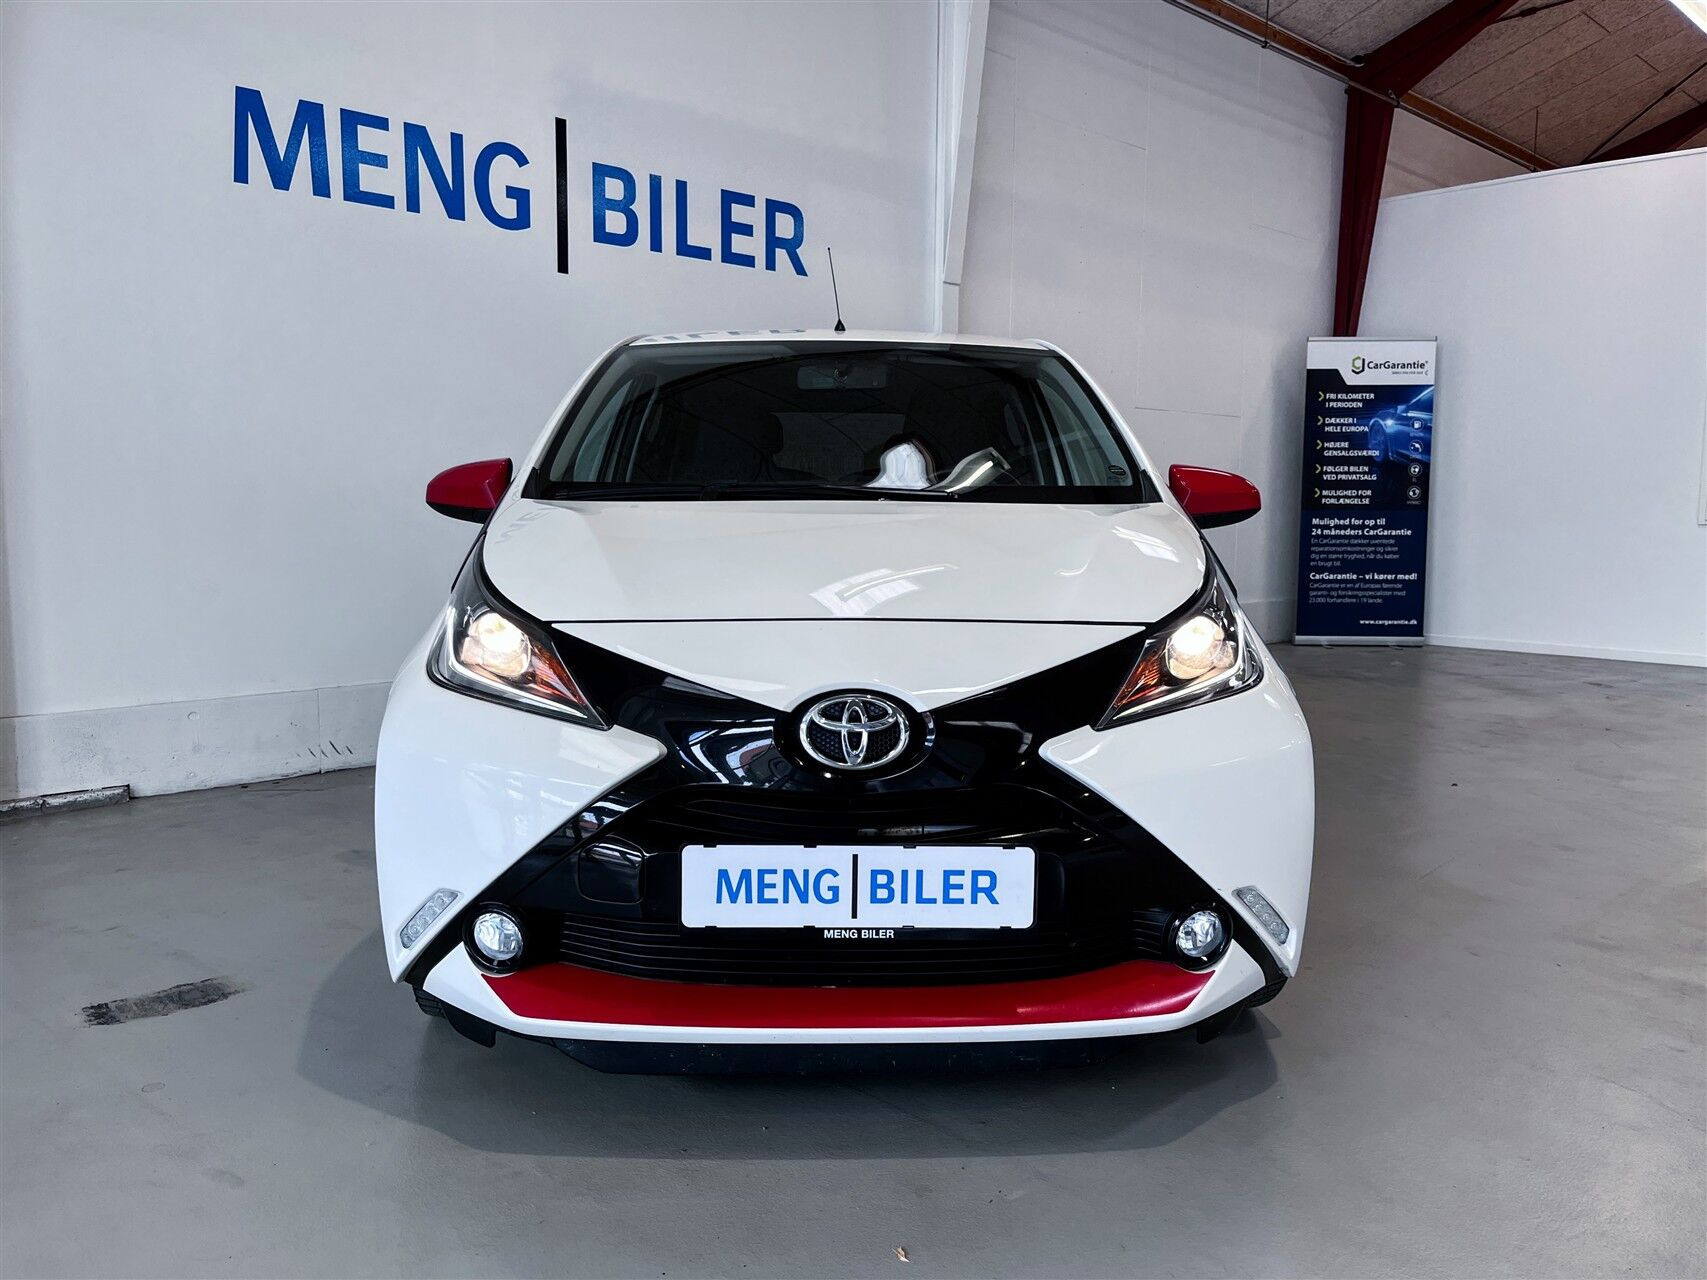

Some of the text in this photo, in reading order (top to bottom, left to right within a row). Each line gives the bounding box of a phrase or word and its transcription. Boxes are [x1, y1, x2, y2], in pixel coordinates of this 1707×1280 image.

[233, 85, 808, 278] MENG BILER
[1367, 361, 1426, 369] CarGarantie
[1338, 473, 1377, 481] PRIVATSALG
[1312, 518, 1350, 526] Mulighed
[1364, 528, 1412, 536] CarGarantie
[715, 868, 999, 905] MENG BILER
[823, 929, 894, 939] MENG BILER
